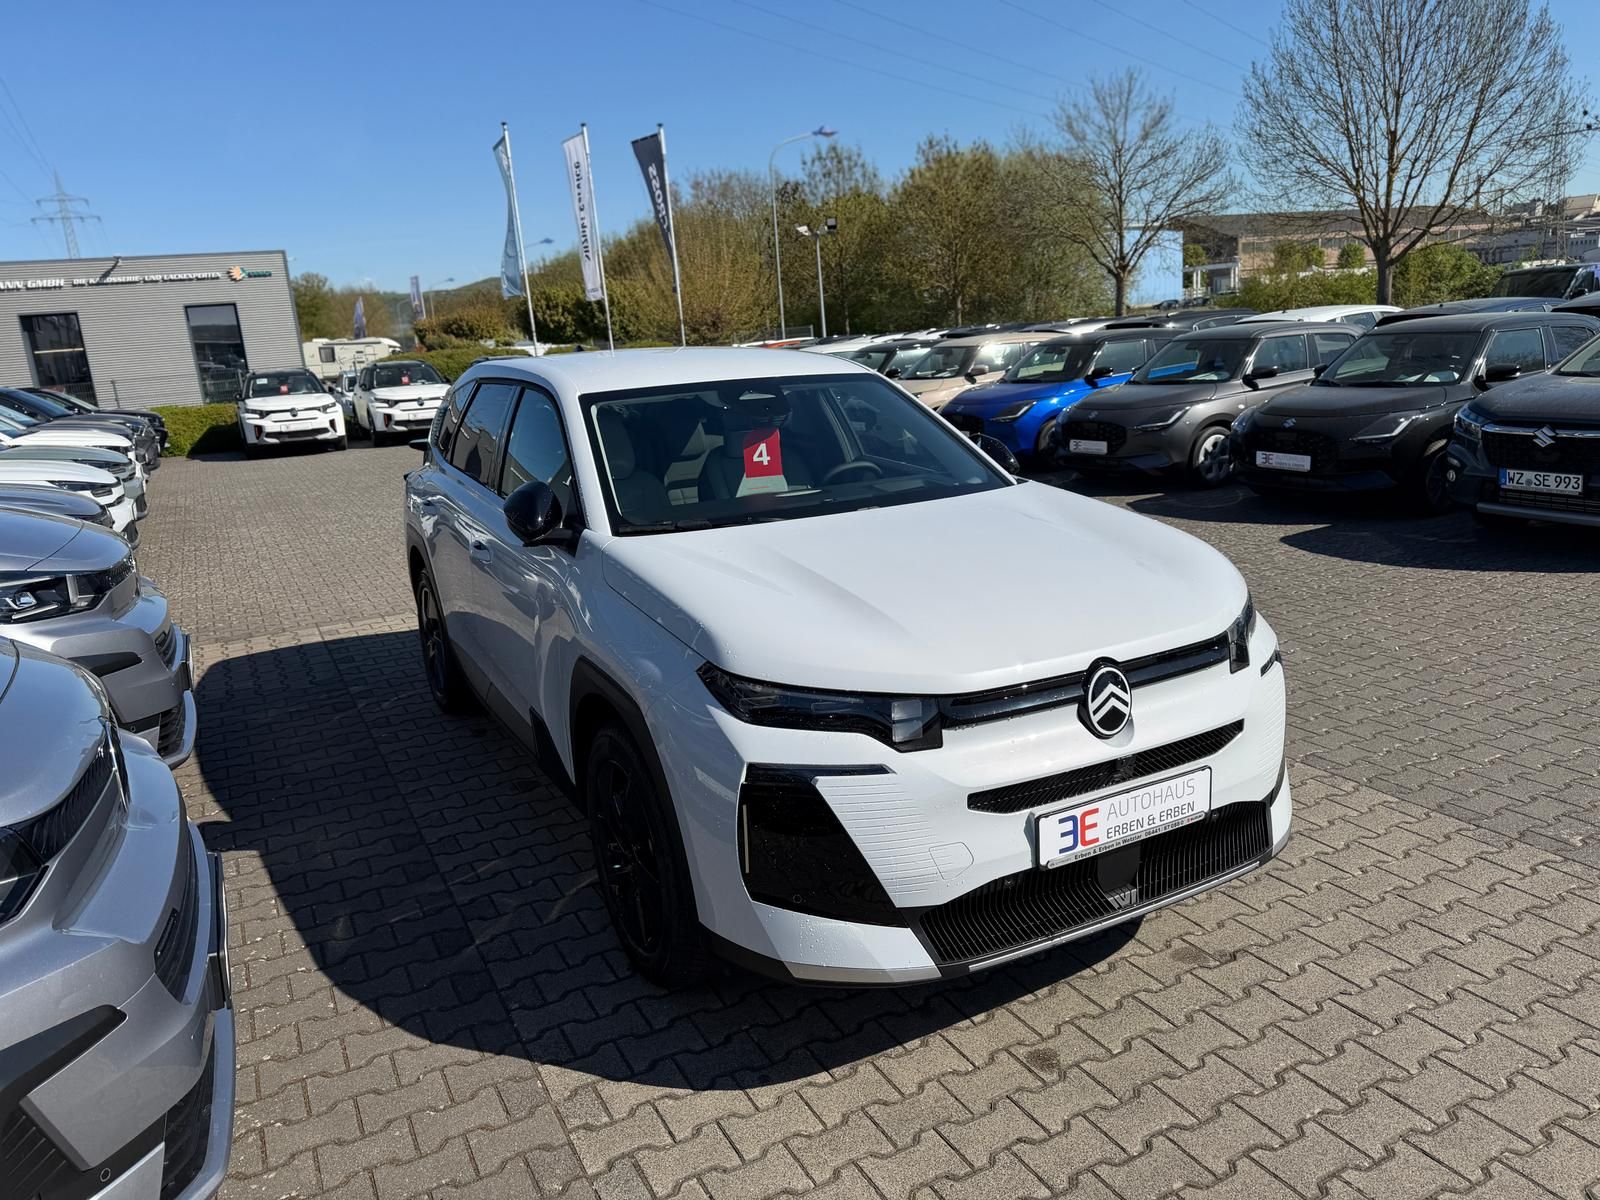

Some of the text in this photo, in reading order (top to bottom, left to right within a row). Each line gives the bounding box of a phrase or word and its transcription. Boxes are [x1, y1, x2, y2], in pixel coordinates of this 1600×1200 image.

[753, 443, 771, 466] 4
[1508, 472, 1580, 489] WZ SE 993
[1106, 778, 1195, 821] AUTOHAUS
[1106, 816, 1144, 839] ERBEN
[1148, 814, 1156, 826] &
[1160, 801, 1195, 822] ERBEN
[1074, 850, 1091, 860] Erben
[1098, 843, 1115, 853] Erben
